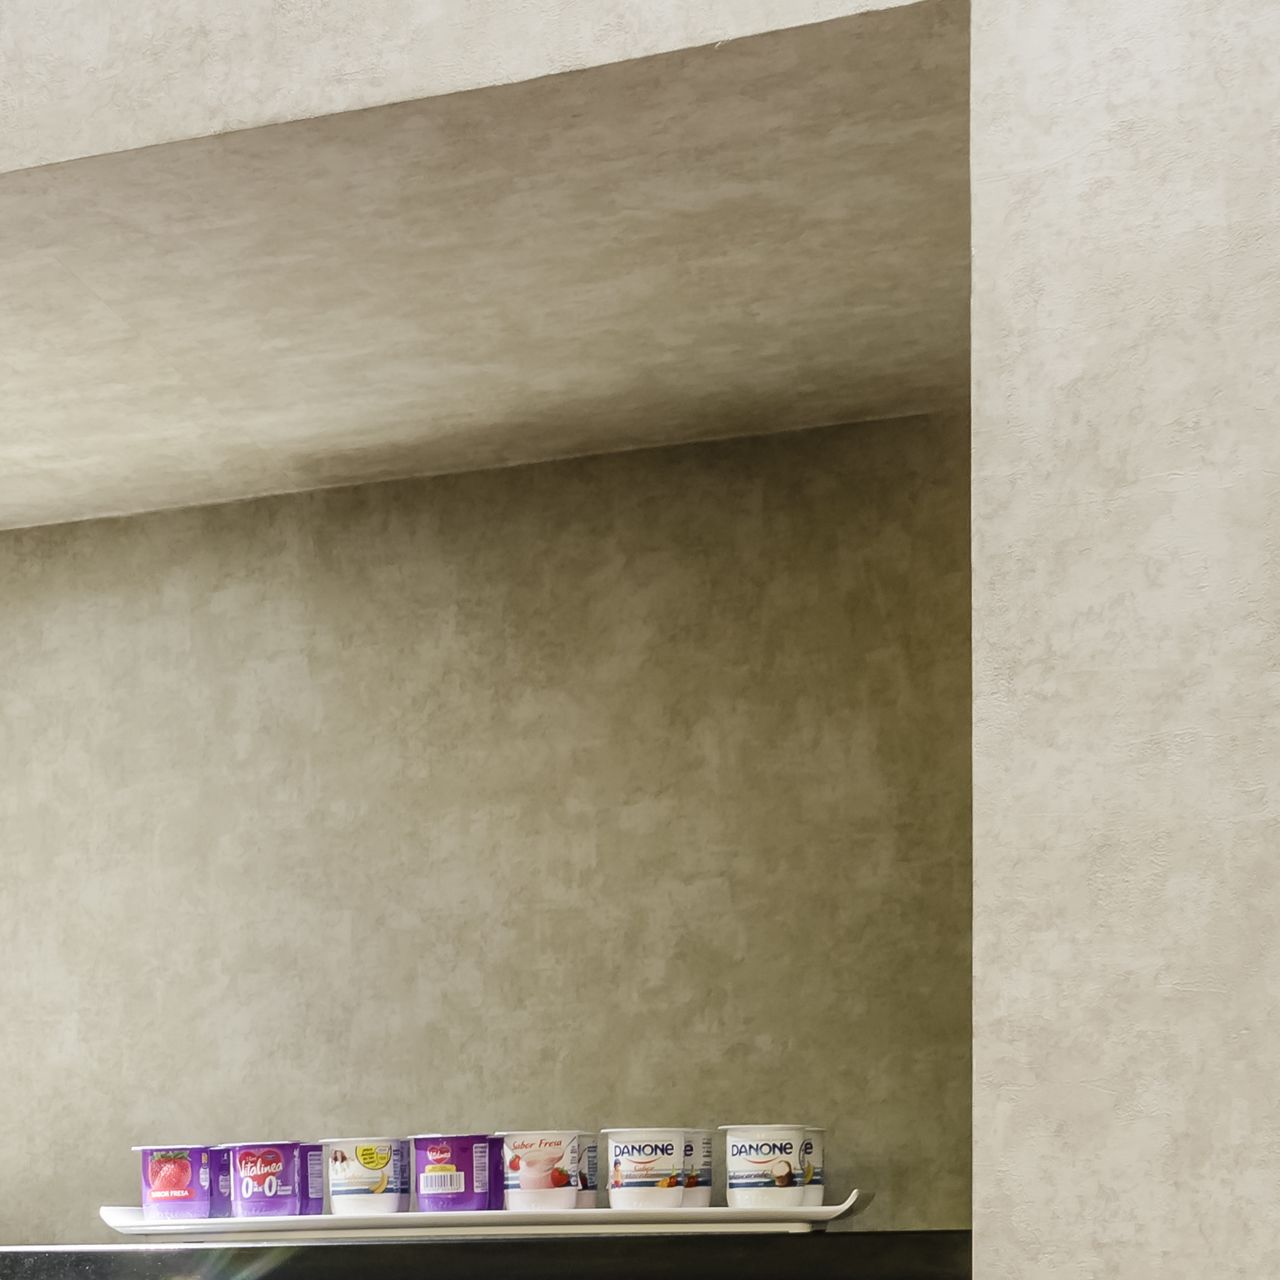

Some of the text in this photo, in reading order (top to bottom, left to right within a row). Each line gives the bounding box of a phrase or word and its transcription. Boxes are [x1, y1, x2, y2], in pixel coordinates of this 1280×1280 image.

[511, 1138, 562, 1150] Sabor Fresa
[614, 1143, 674, 1157] DANONE
[731, 1142, 793, 1156] DANONE
[237, 1158, 283, 1178] Vitalinea
[170, 1189, 189, 1197] FRESA
